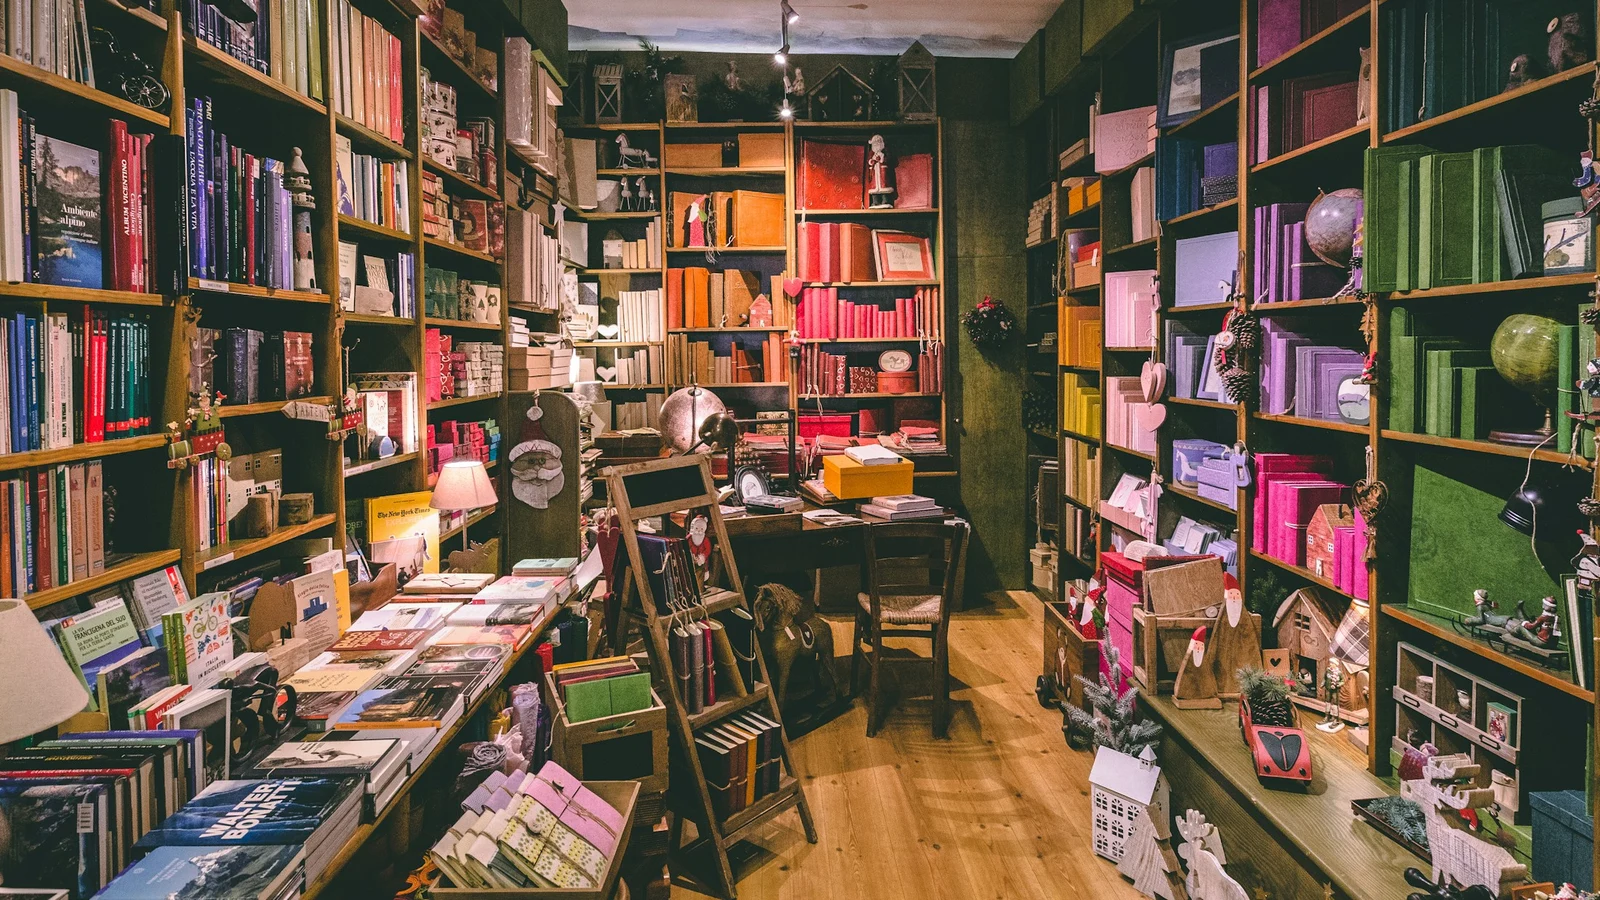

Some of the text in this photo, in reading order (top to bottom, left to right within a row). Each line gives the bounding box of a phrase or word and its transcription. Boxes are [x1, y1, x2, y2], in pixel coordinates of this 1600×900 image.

[191, 196, 196, 207] LA
[61, 204, 98, 218] Ambiente
[60, 216, 85, 227] alpino
[401, 509, 414, 517] York
[74, 624, 105, 640] FRANCIGENA
[116, 615, 126, 623] SUD
[103, 634, 114, 642] SANTA
[206, 656, 218, 667] ITALIA
[204, 660, 226, 676] BICICLETTA
[199, 783, 279, 838] WALTER
[221, 780, 302, 840] BONATTI
